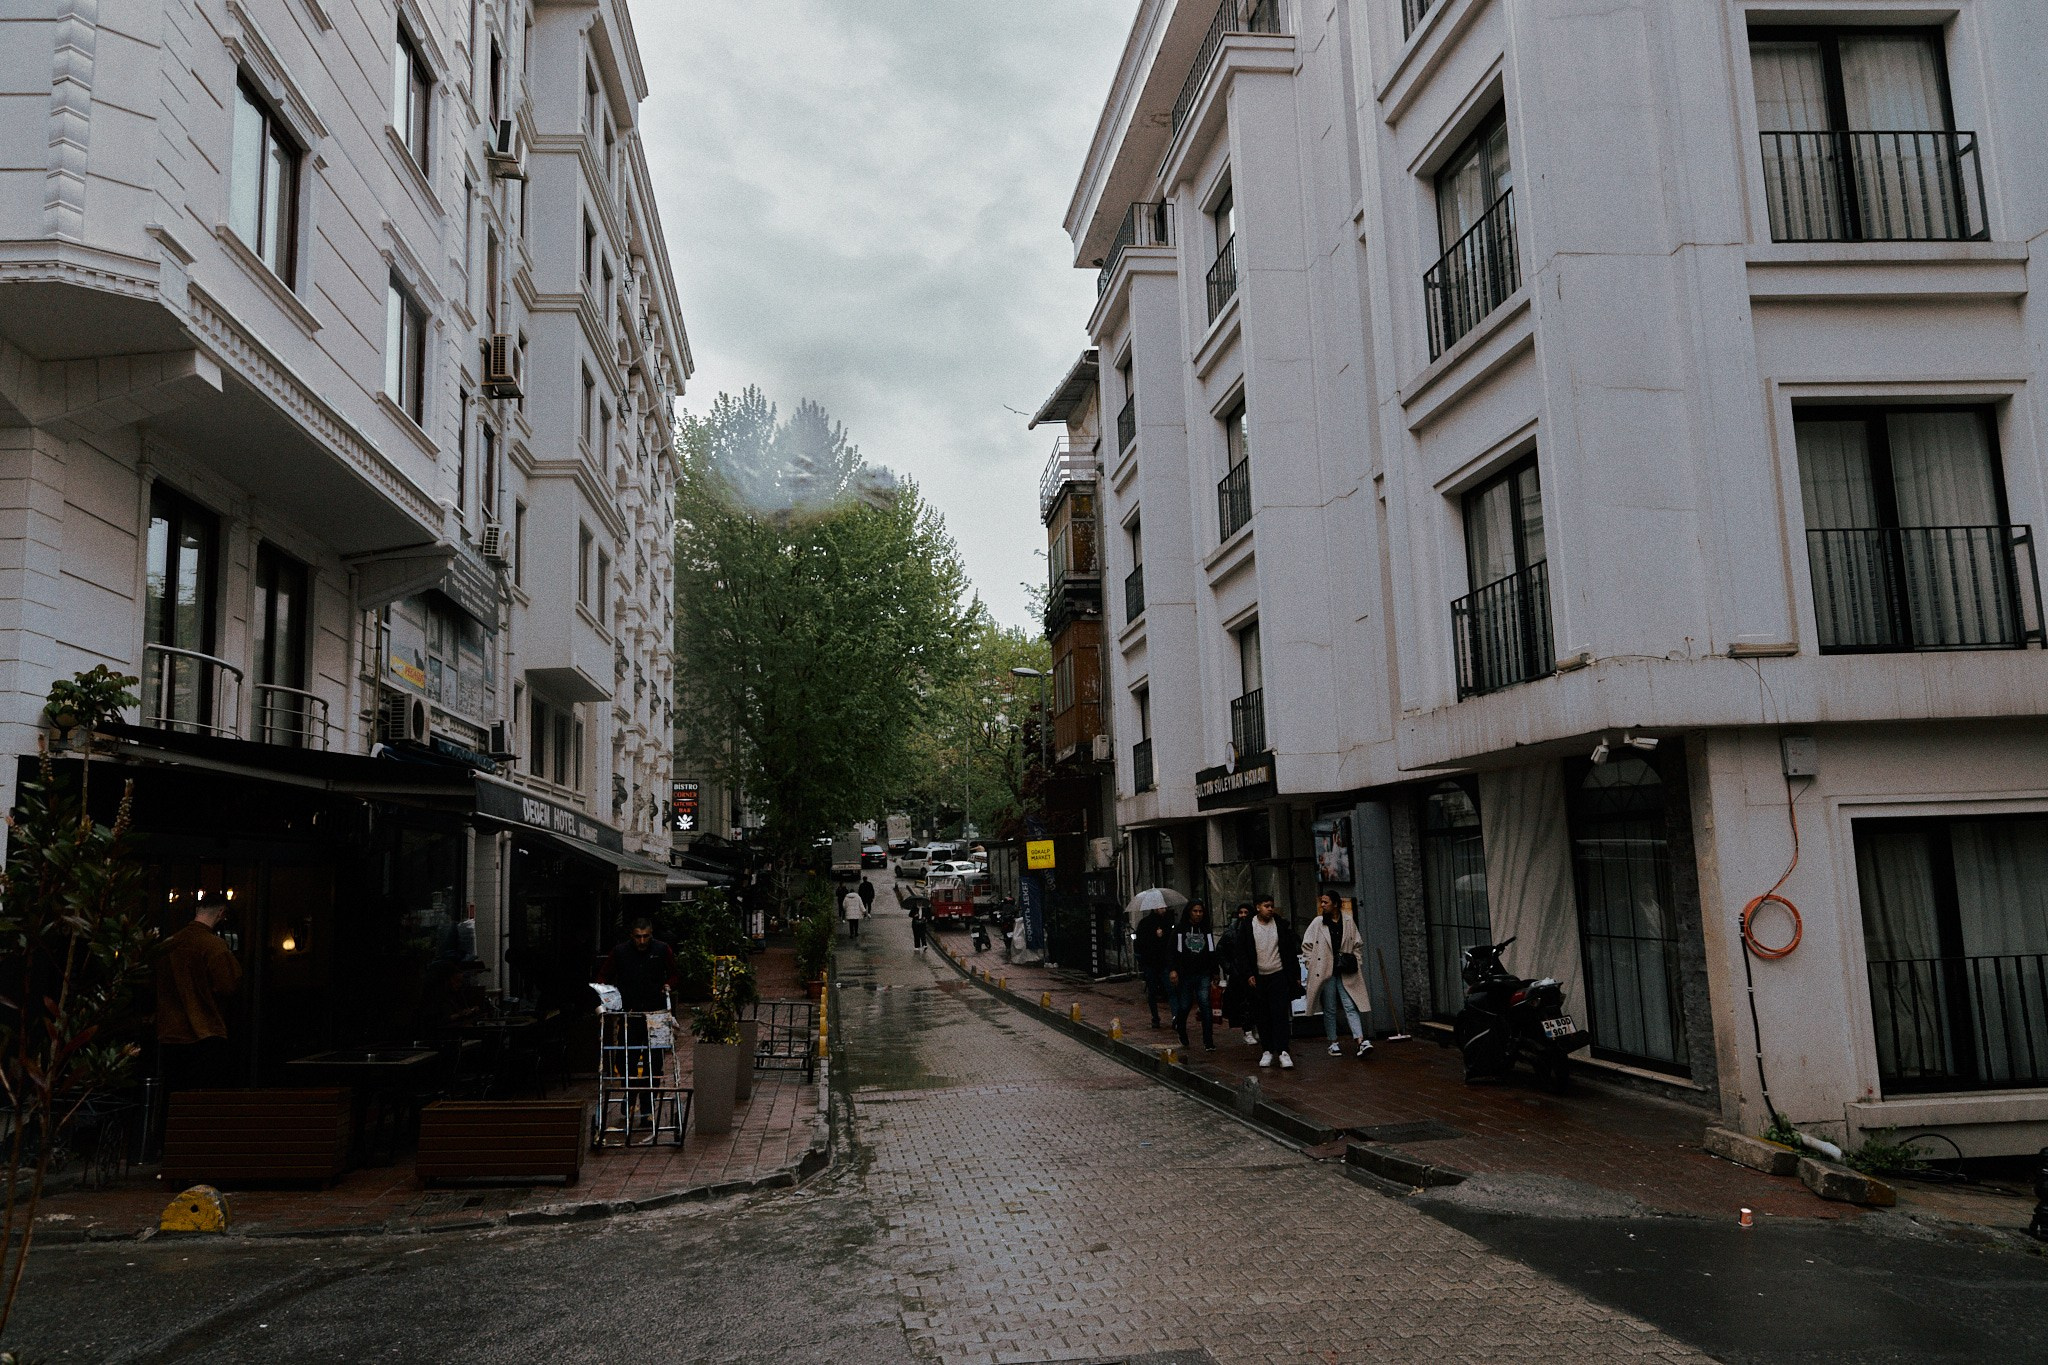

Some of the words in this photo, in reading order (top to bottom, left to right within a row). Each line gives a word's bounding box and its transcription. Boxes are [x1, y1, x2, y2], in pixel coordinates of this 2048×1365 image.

[522, 797, 550, 828] DEDEM
[553, 807, 577, 836] HOTEL
[1544, 1021, 1555, 1029] 34
[1552, 1027, 1567, 1036] 907
